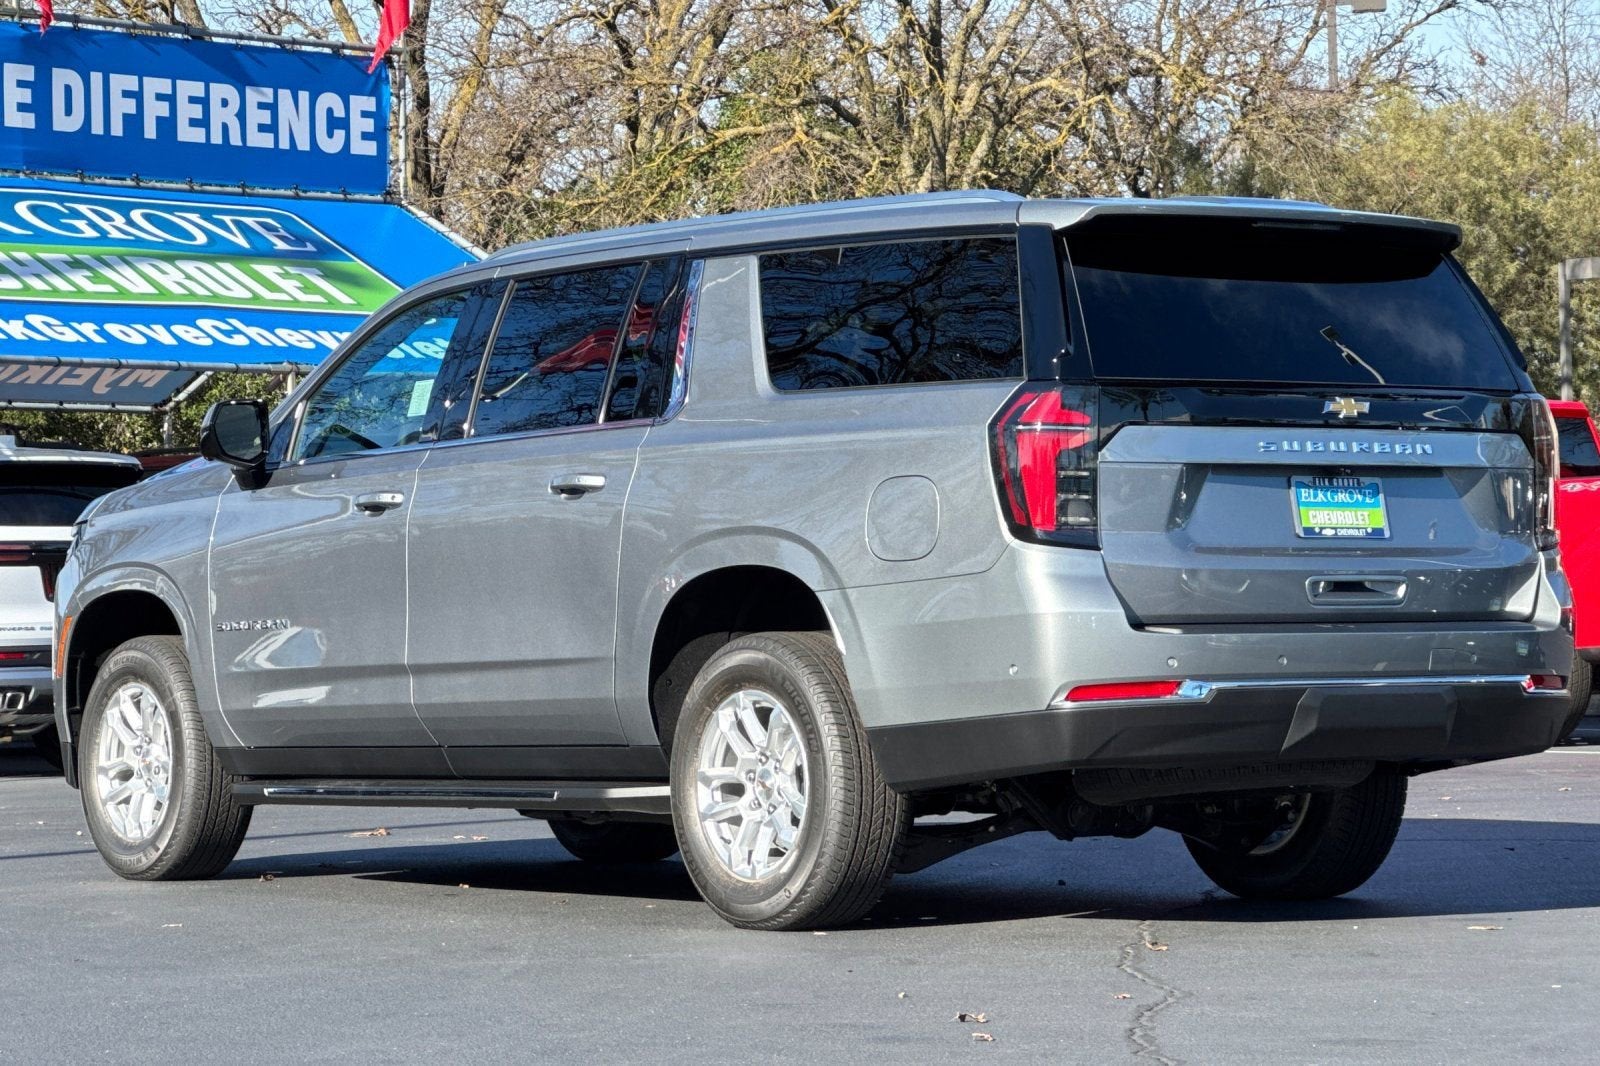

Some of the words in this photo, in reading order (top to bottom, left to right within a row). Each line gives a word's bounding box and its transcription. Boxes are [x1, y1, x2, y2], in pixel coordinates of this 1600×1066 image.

[51, 67, 378, 156] DIFFERENCE
[13, 200, 318, 252] GROVE
[1257, 440, 1434, 454] SUBURBAN
[1308, 510, 1370, 525] CHEVROLET
[216, 619, 290, 631] SUBURBAN
